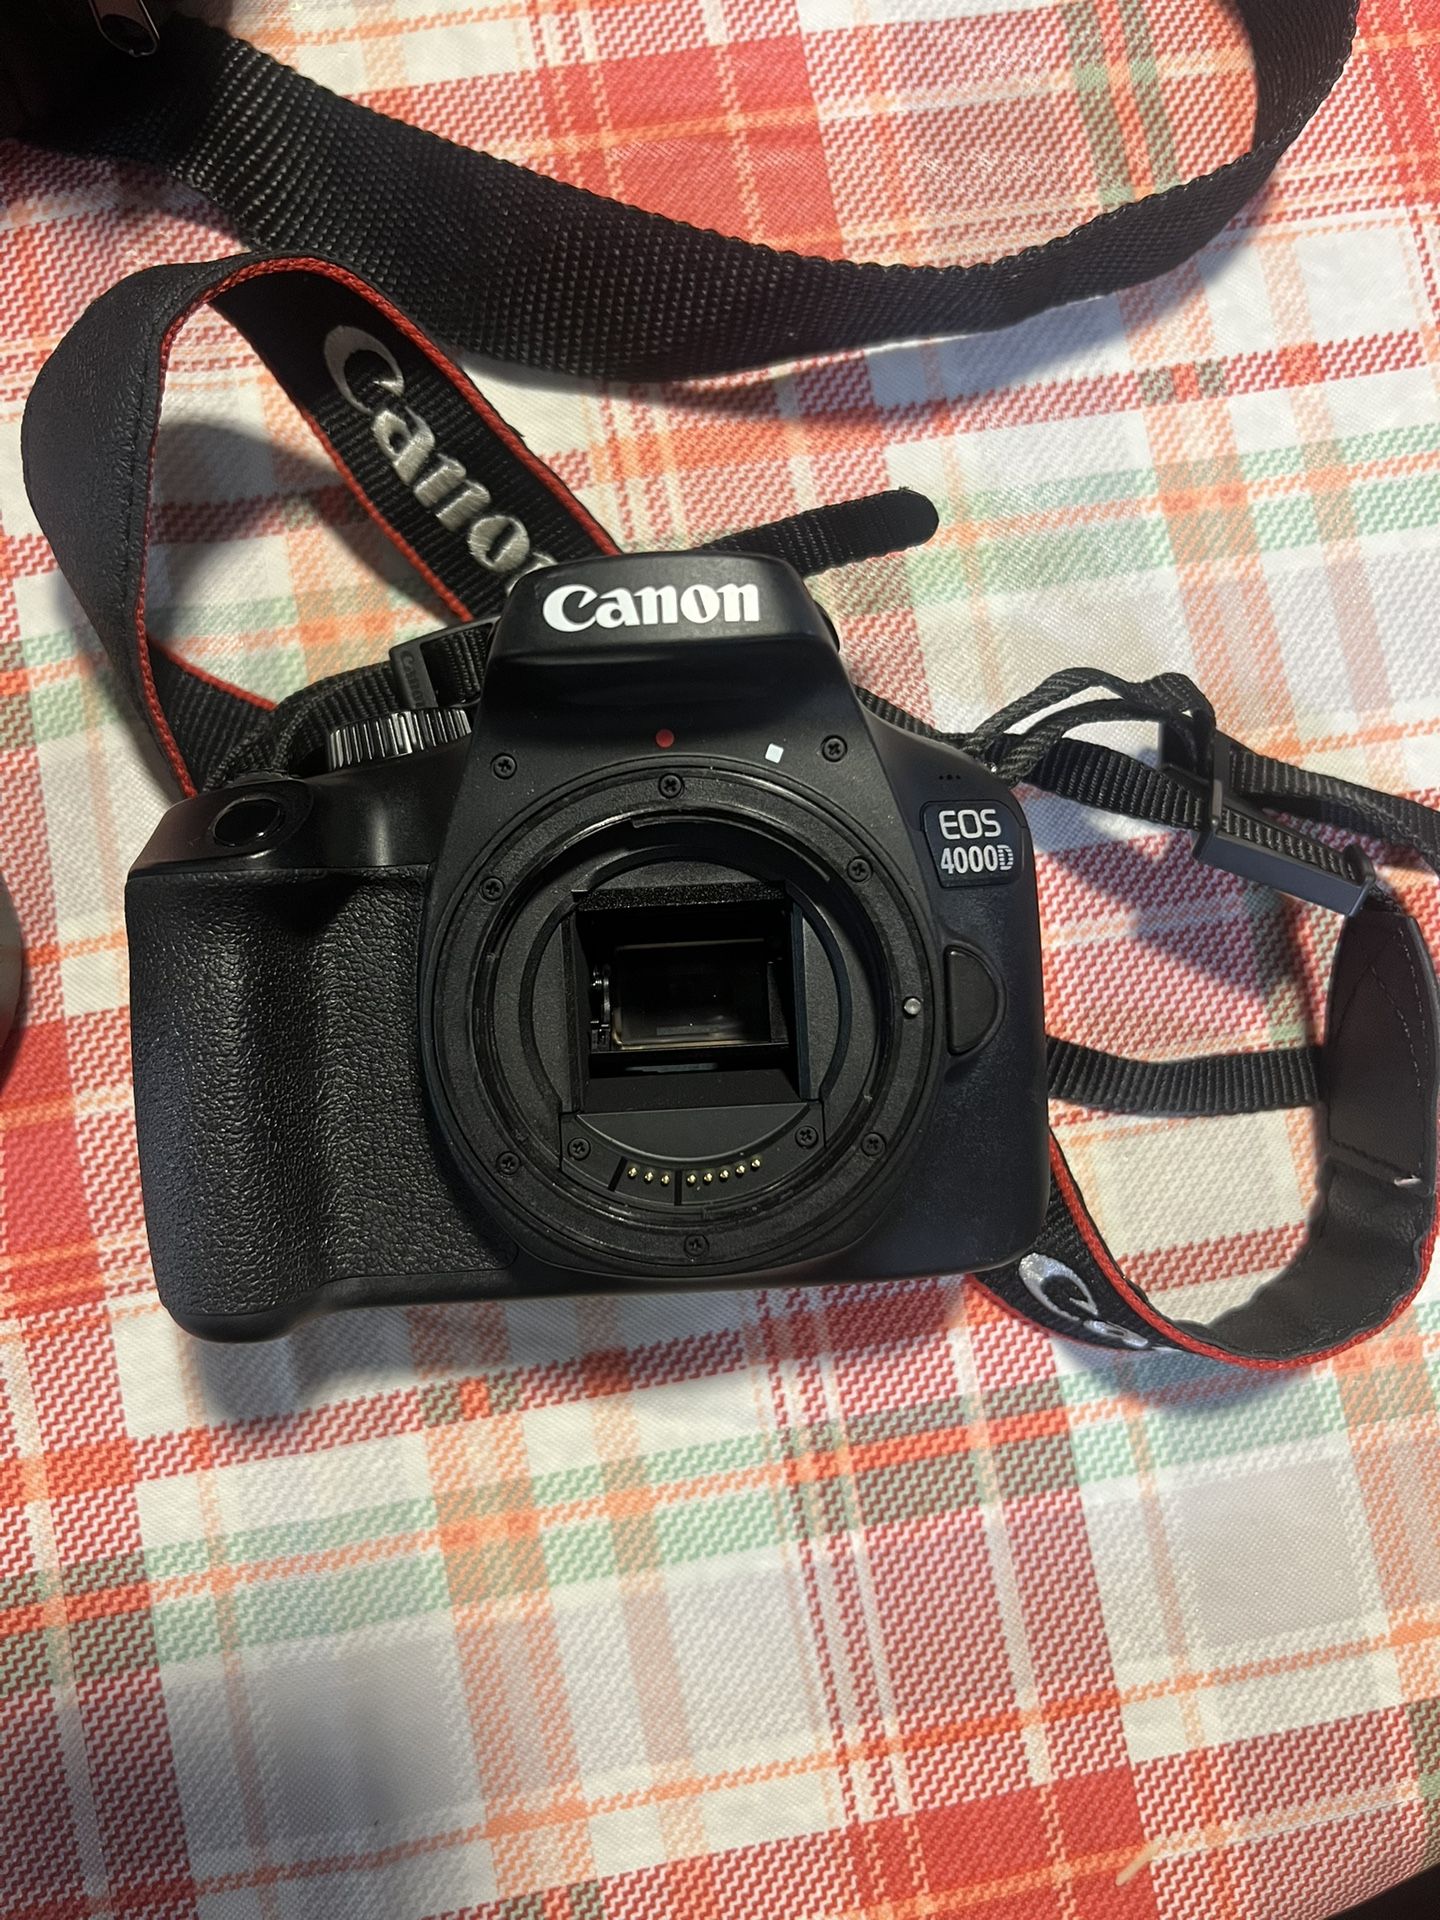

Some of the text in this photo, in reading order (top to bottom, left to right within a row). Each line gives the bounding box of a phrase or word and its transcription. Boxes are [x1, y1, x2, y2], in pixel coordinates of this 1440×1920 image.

[323, 324, 558, 596] Cano
[542, 582, 761, 633] Canon
[939, 808, 1002, 840] EOS
[940, 844, 1014, 875] 4000D
